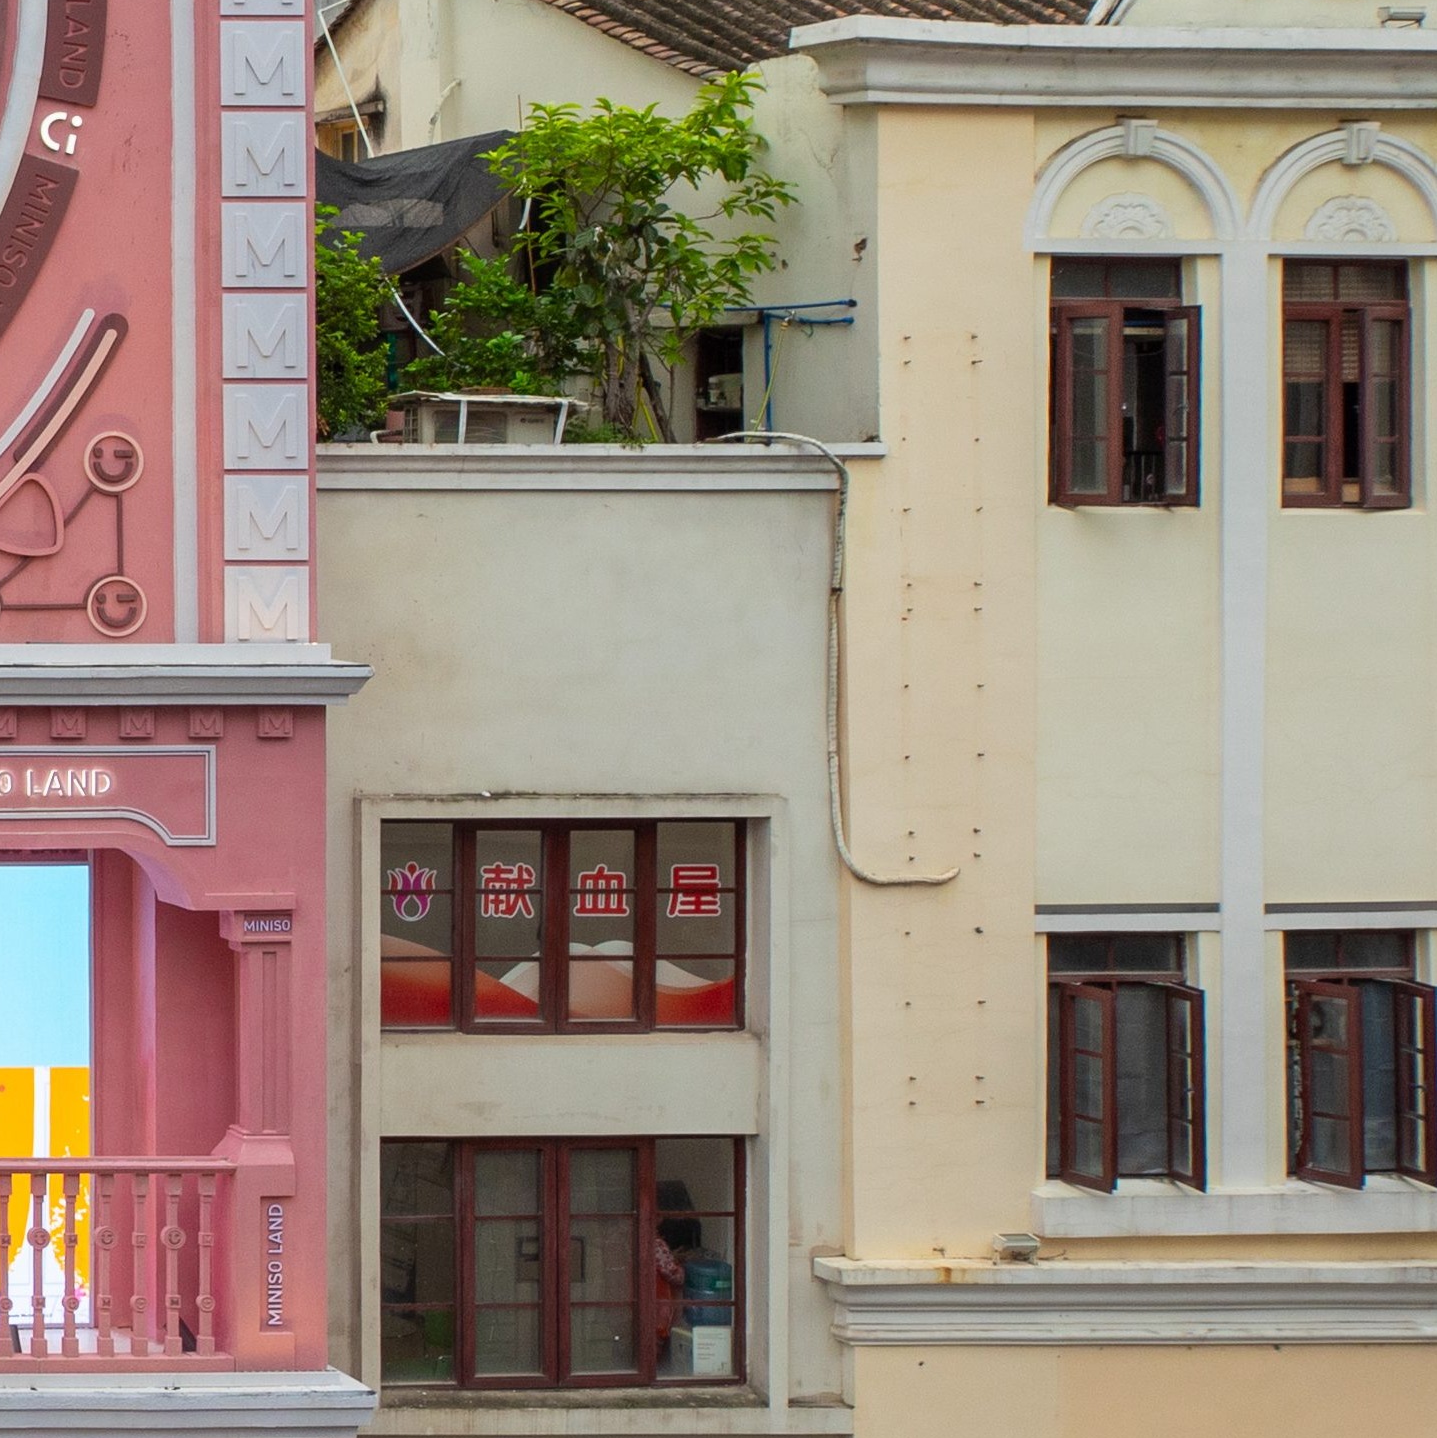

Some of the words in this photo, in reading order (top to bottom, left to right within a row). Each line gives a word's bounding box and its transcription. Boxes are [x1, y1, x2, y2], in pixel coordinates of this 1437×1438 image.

[25, 767, 114, 798] LAND
[480, 862, 723, 919] 献血屋
[243, 918, 291, 934] MINISO
[268, 1202, 284, 1255] LAND
[268, 1259, 284, 1327] MINISO
